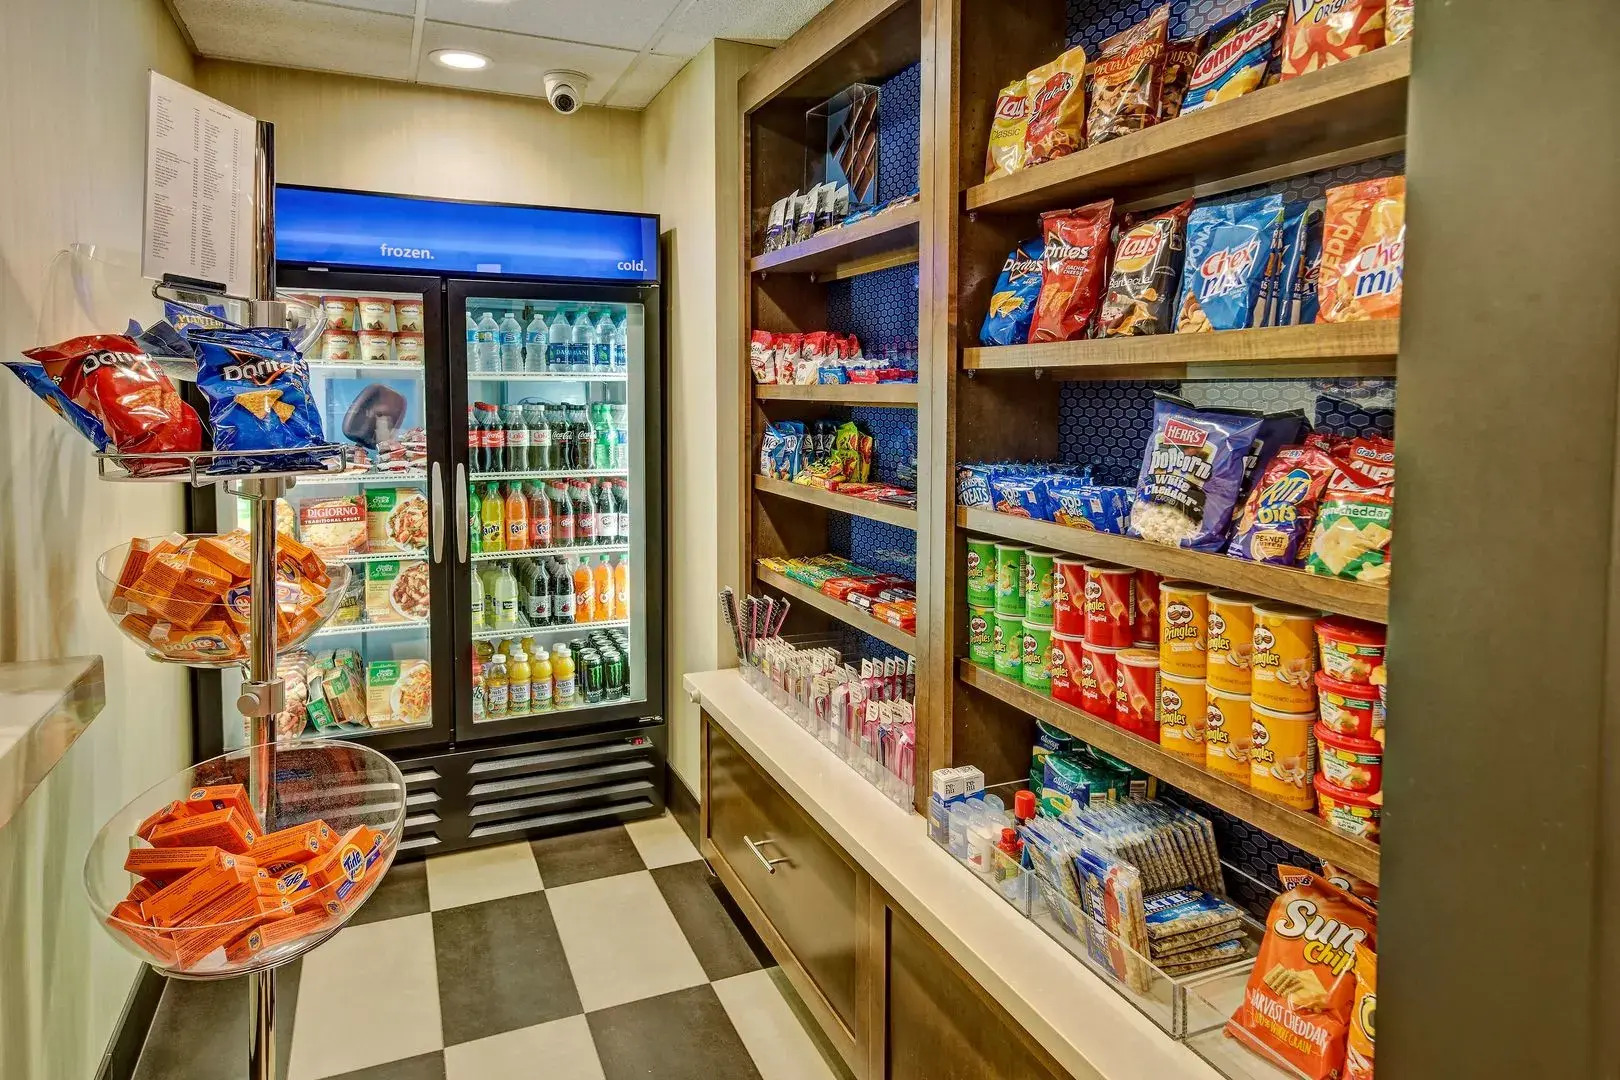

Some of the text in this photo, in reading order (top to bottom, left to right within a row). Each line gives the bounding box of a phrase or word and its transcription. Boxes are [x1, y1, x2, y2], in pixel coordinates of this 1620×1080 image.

[380, 243, 434, 260] frozen.
[617, 259, 648, 272] cold.
[1110, 276, 1153, 289] Barbecue
[223, 358, 308, 381] Doritos
[1167, 425, 1202, 444] HERR'S
[1356, 447, 1376, 458] Grab
[1164, 624, 1198, 643] Pringles
[163, 637, 216, 651] bounce
[344, 851, 362, 871] Tide
[1274, 899, 1367, 955] Sun
[1303, 940, 1355, 977] Chip
[1250, 990, 1328, 1050] HARVEST CHEDDAR
